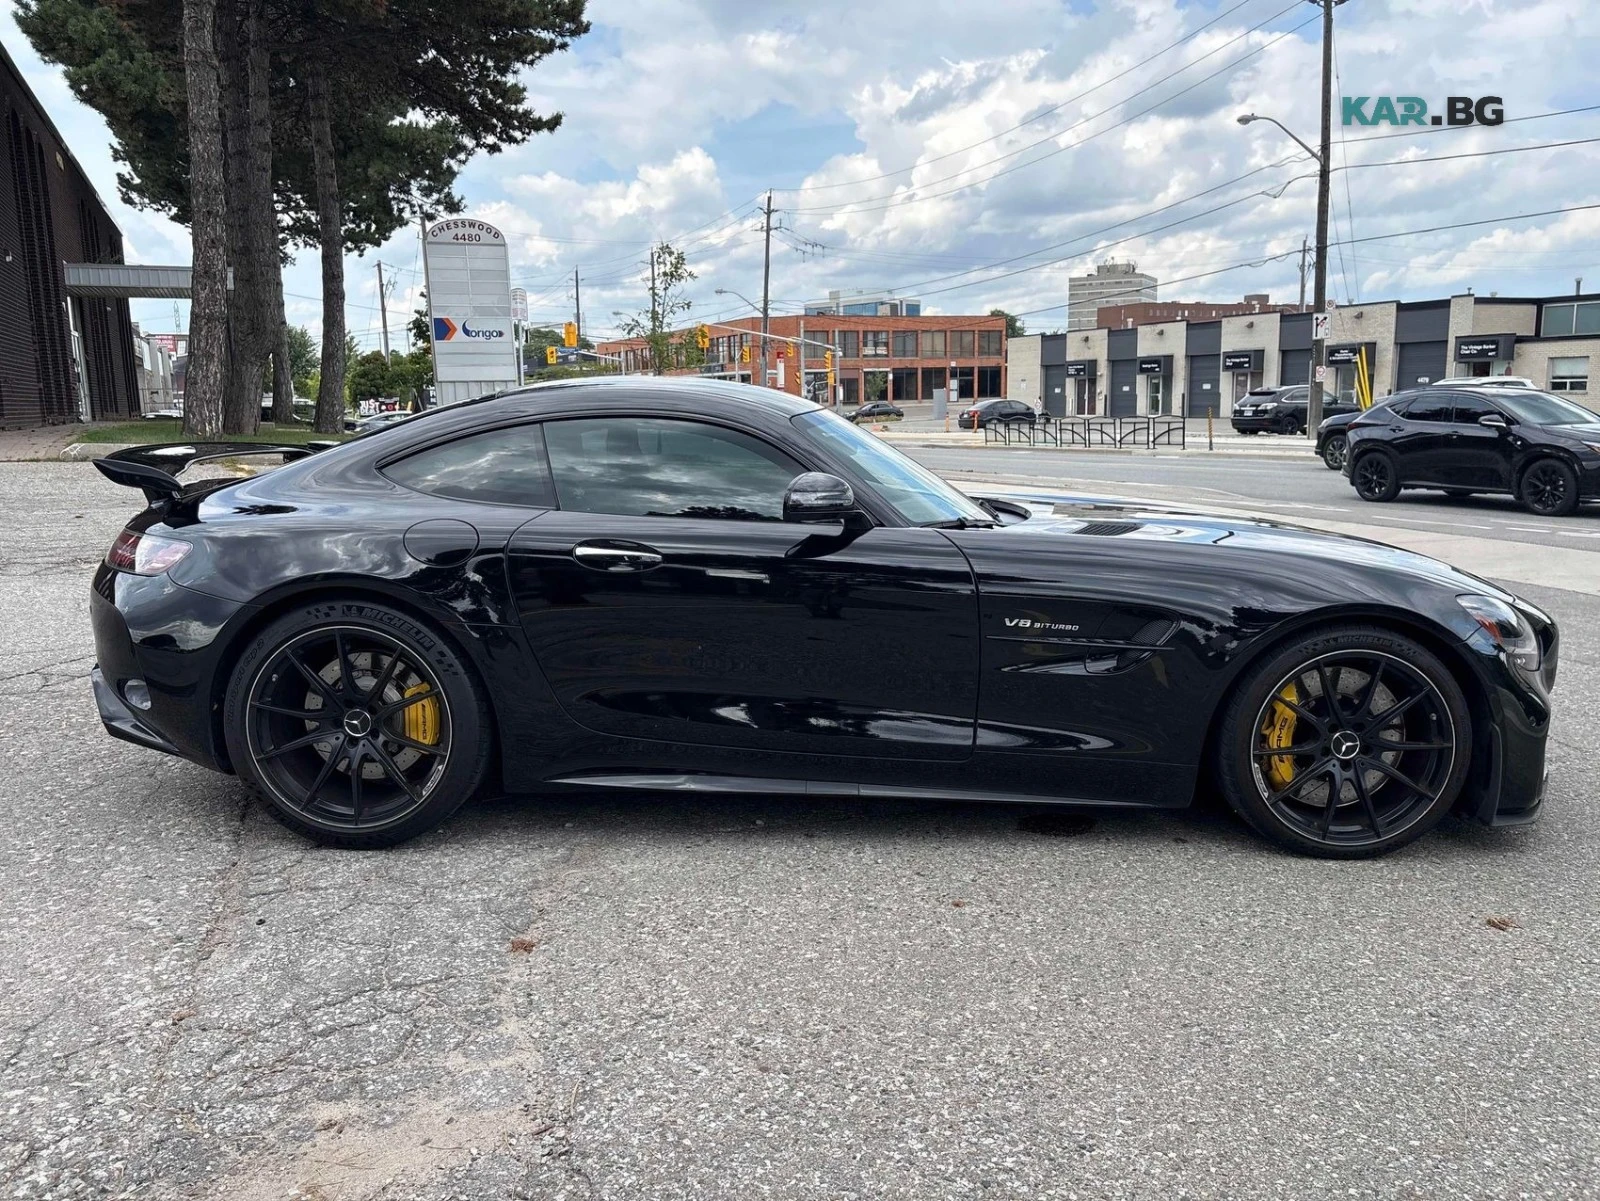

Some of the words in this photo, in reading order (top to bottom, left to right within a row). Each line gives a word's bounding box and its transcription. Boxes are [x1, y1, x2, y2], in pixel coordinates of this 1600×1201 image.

[431, 220, 500, 240] CHESSWOOD
[452, 233, 481, 242] 4480
[361, 607, 436, 650] MICHELIN
[1004, 617, 1031, 628] V8
[1033, 622, 1079, 631] BITURBO
[1337, 634, 1393, 647] MICHELIN
